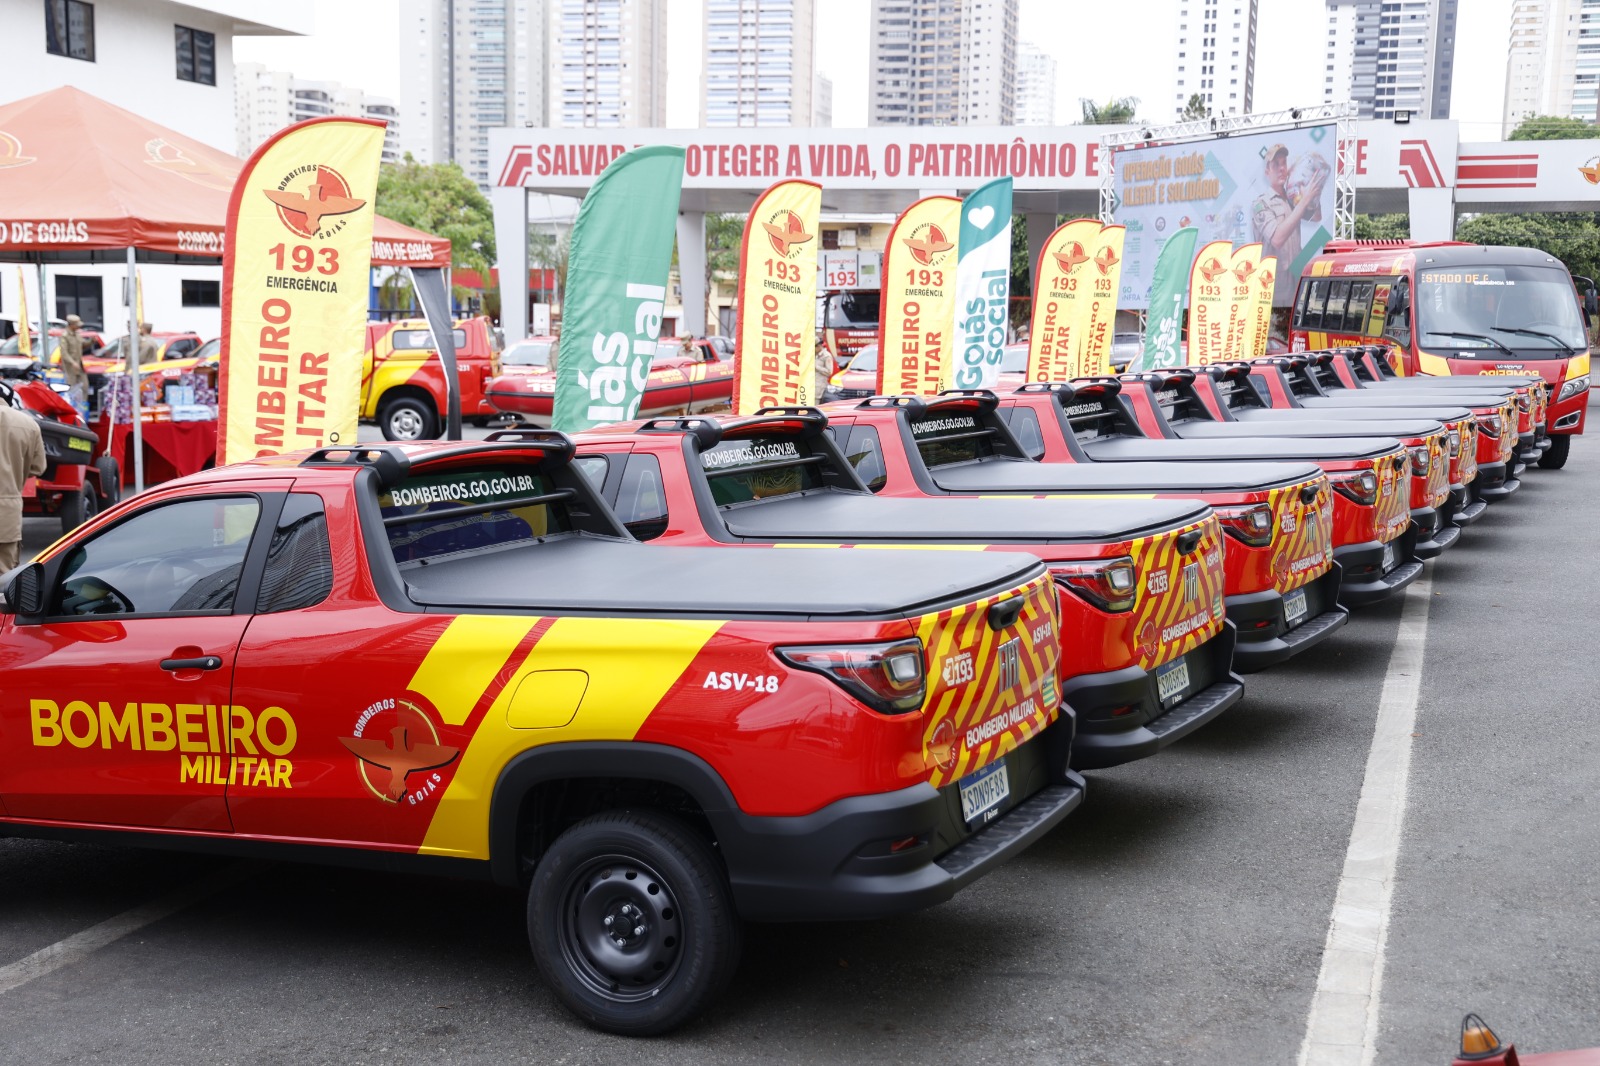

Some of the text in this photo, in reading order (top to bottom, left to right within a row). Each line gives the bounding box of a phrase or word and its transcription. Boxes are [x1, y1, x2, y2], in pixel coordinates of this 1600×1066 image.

[686, 144, 779, 177] OTEGER
[786, 144, 807, 176] A
[808, 144, 876, 180] VIDA,
[884, 143, 901, 177] O
[908, 137, 1076, 177] PATRIMÔNIO
[1085, 143, 1099, 176] E
[1123, 153, 1204, 183] OPERAÇÃO GOIÁS
[278, 164, 317, 191] BOMBEIROS
[1123, 177, 1220, 207] ALERTA E SOLIDÁRIO
[11, 221, 34, 243] DE
[37, 218, 89, 243] GOIÁS
[177, 230, 219, 251] CORPO
[319, 219, 346, 240] GOIÁS
[268, 243, 339, 275] 193
[393, 243, 407, 260] DE
[407, 240, 434, 261] GOIÁS
[266, 276, 338, 293] EMERGÊNCIA
[764, 258, 801, 283] 193
[828, 271, 857, 286] 193
[906, 269, 943, 287] 193
[1051, 277, 1077, 291] 193
[1094, 279, 1111, 290] 193
[763, 279, 802, 294] EMERGÊNCIA
[905, 288, 943, 297] EMERGÊNCIA
[1199, 285, 1221, 295] 193
[1232, 285, 1249, 295] 193
[1259, 291, 1272, 299] 193
[982, 267, 1007, 366] social
[1253, 307, 1263, 355] OMBEIRO
[956, 297, 986, 389] Goiás
[1037, 302, 1058, 382] OMBEIRO
[1083, 301, 1099, 374] OMBEIRO
[1197, 304, 1208, 366] OMBEIRO
[1223, 304, 1238, 361] OMBEIRO
[759, 295, 779, 410] OMBEIRO
[900, 301, 920, 395] MBEIRO
[1053, 327, 1070, 381] ILITAR
[254, 298, 292, 458] MBEIRO
[578, 332, 629, 424] iás
[784, 332, 801, 405] LITAR
[924, 332, 941, 395] LITAR
[527, 384, 556, 392] 19
[911, 417, 975, 434] BOMBEIROS.GO.GOV.BR
[704, 441, 797, 466] BOMBEIROS.GO.GOV.BR
[391, 475, 535, 507] BOMBEIROS.GO.GOV.BR
[1154, 575, 1169, 594] 193
[1162, 619, 1190, 643] BOMBEIRO
[953, 658, 973, 685] 193
[998, 636, 1020, 694] FIAT
[703, 671, 779, 693] ASV-18
[29, 698, 298, 756] BOMBEIRO
[353, 698, 395, 738] BOMBEIROS
[966, 698, 1035, 748] BOMBEIRO MILITAR
[180, 754, 293, 788] MILITAR
[408, 773, 441, 805] GOIÁS
[967, 771, 1005, 814] SDN9F88
